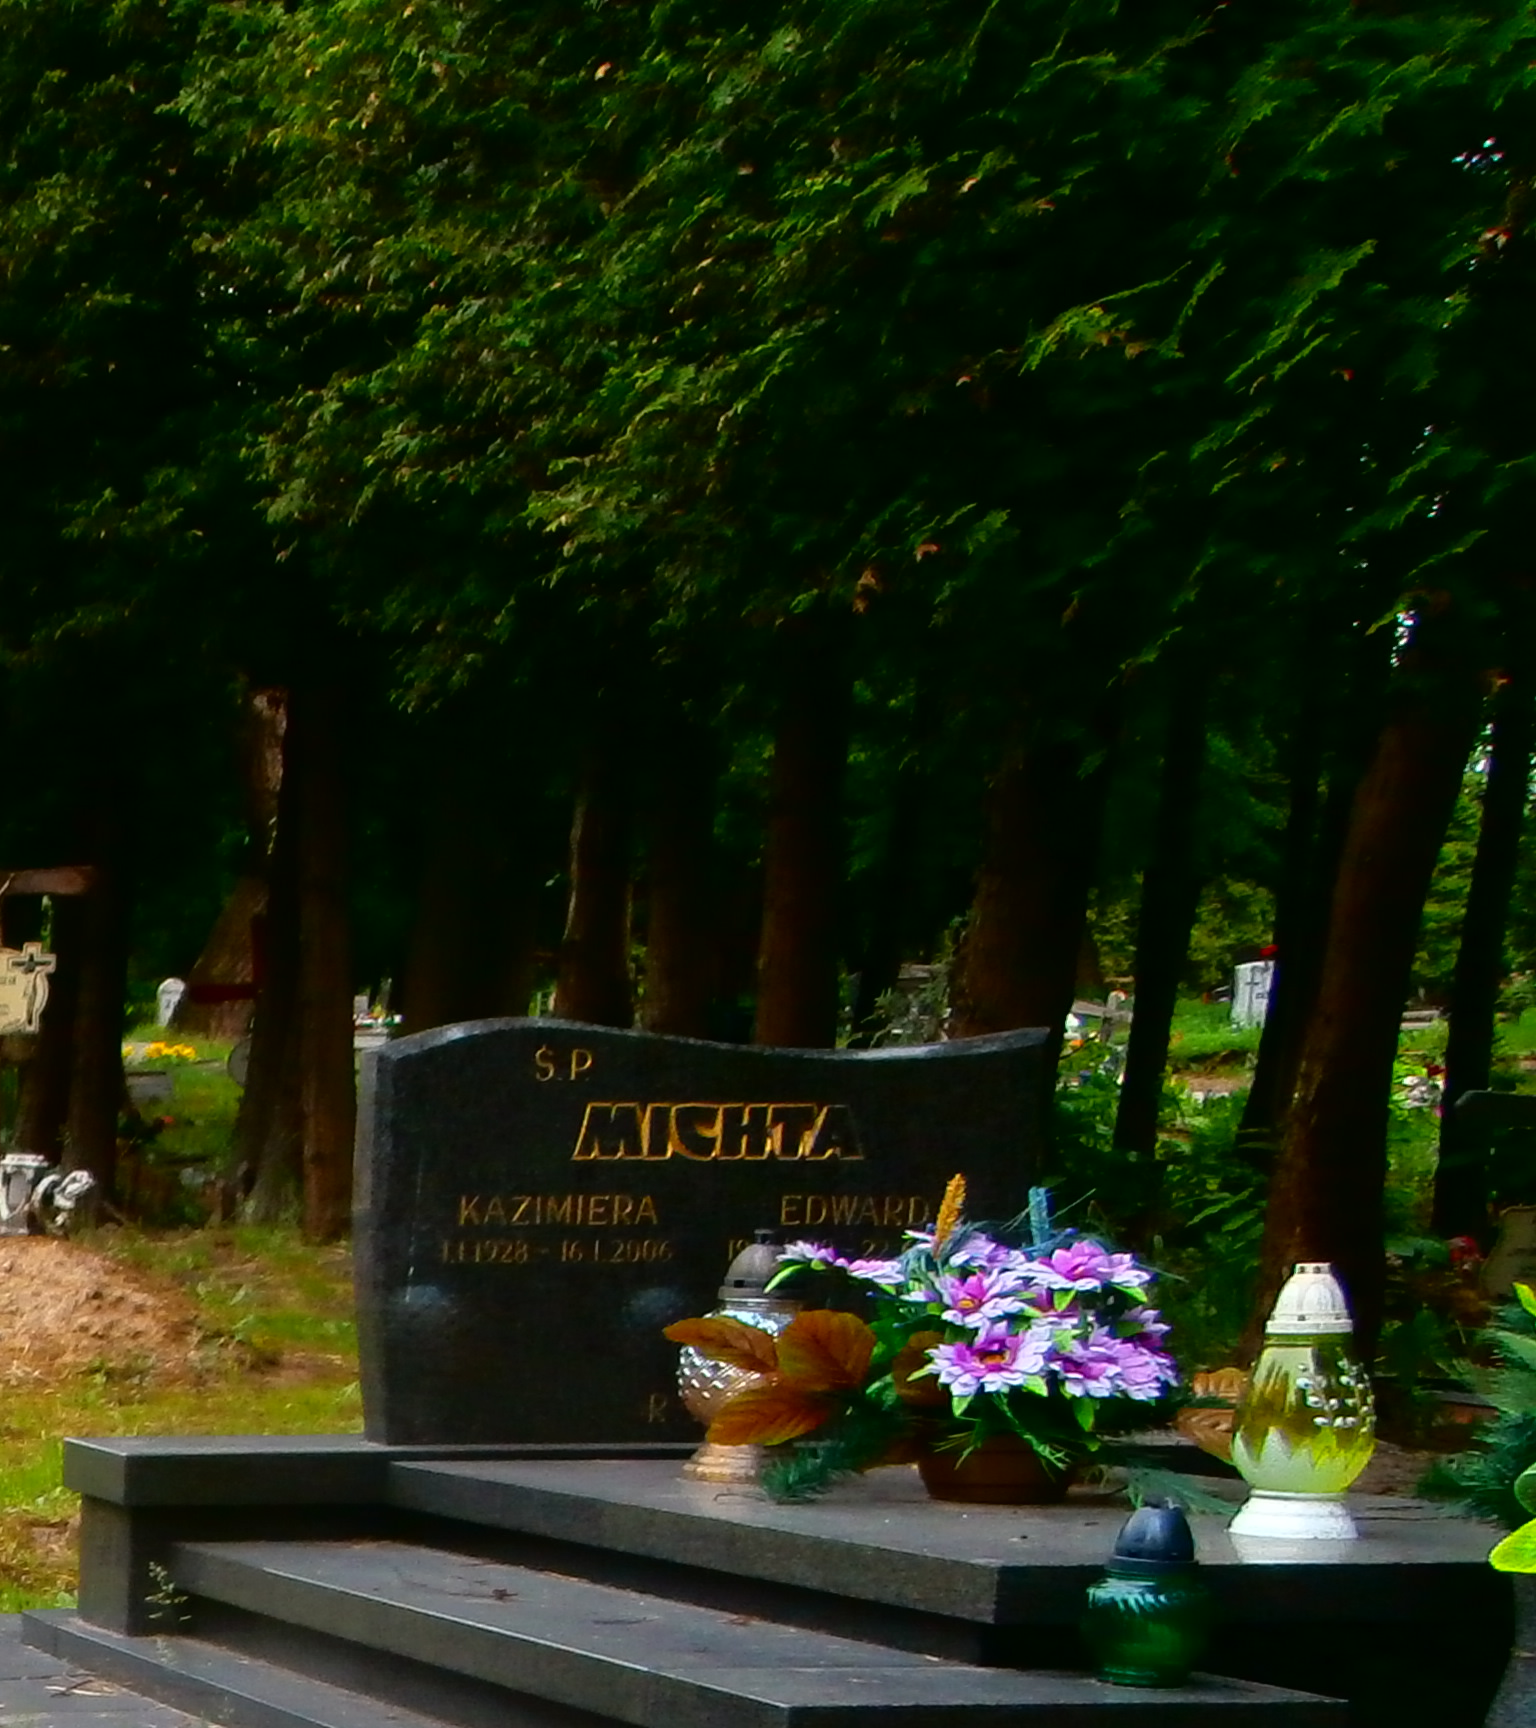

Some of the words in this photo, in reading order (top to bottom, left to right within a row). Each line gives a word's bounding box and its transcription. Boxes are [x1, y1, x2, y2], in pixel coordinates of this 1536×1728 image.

[571, 1101, 865, 1161] MICHTA
[458, 1194, 659, 1226] KAZIMIERA
[780, 1194, 930, 1226] EDWARD
